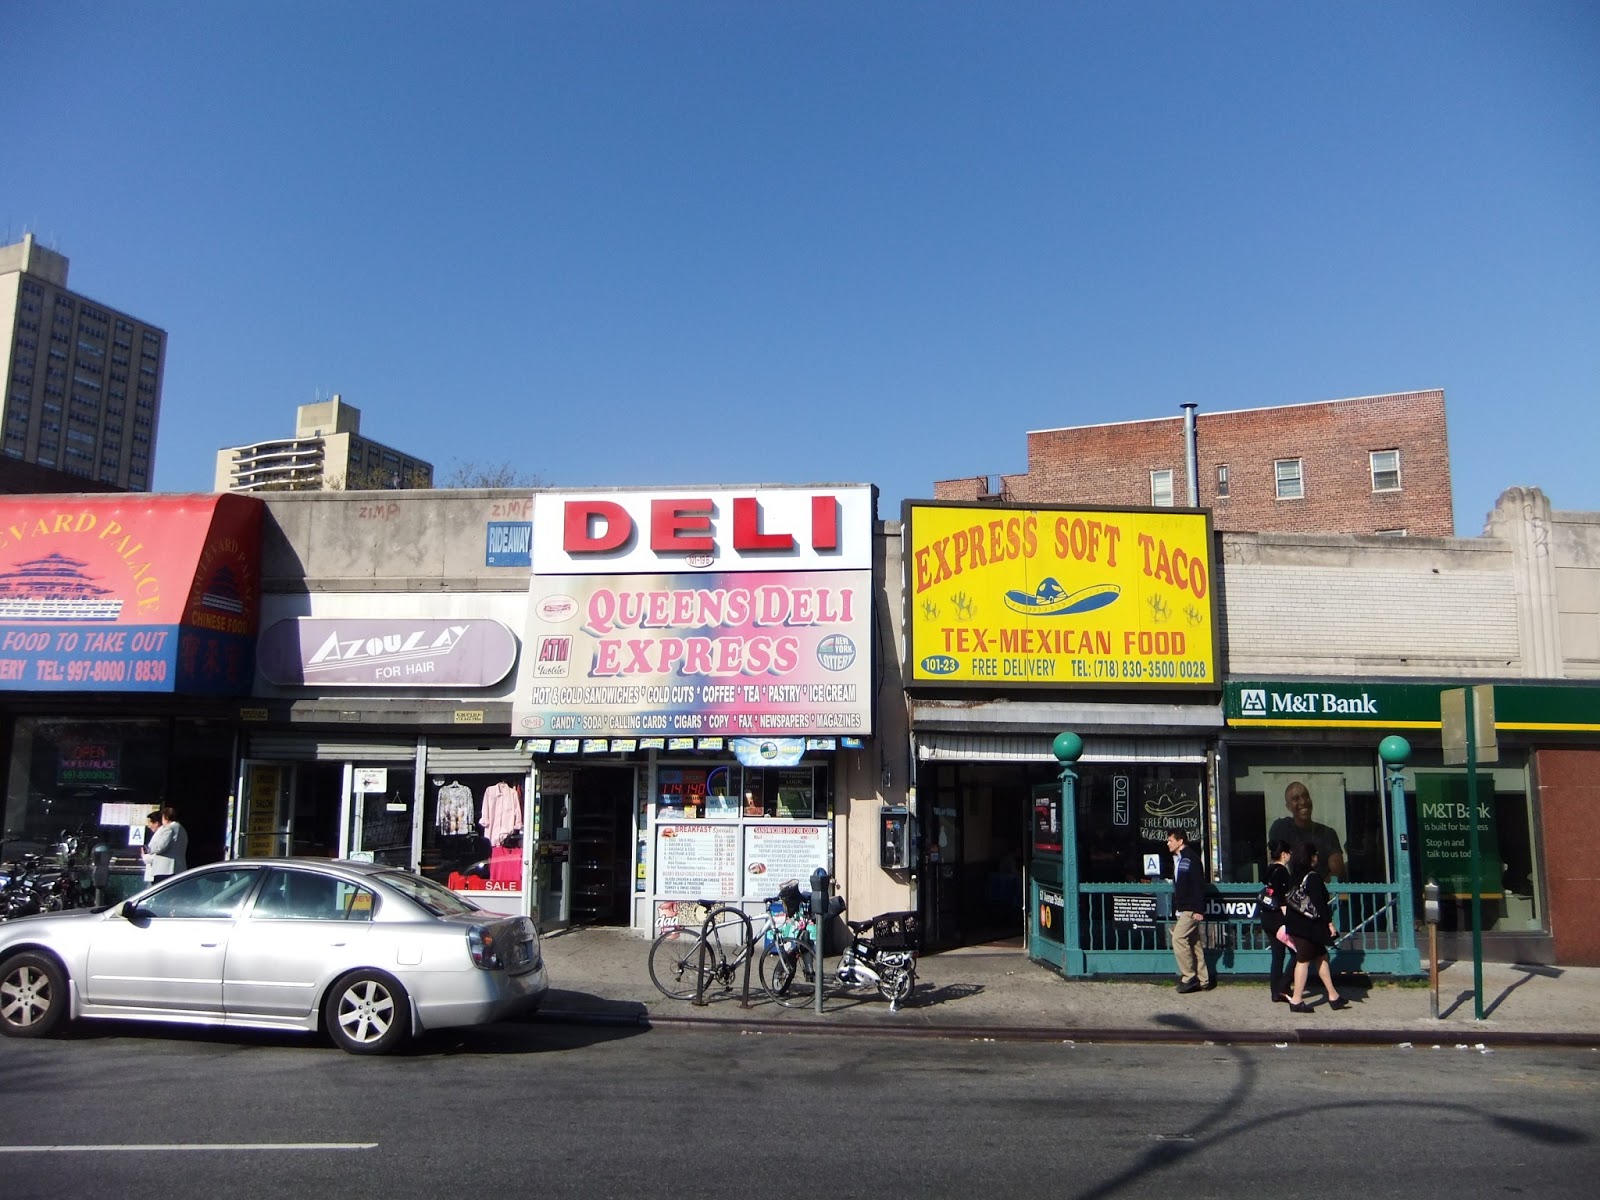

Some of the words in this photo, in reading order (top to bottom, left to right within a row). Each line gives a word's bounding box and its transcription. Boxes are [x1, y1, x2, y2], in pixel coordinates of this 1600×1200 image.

[563, 496, 838, 553] DELI
[99, 520, 160, 616] PALACE
[914, 516, 1038, 594] EXPRESS
[1054, 516, 1121, 568] SOFT
[1137, 532, 1208, 600] TACO
[584, 588, 750, 634] QUEENS
[756, 585, 854, 624] DELI
[191, 610, 227, 632] CHINESE
[227, 618, 249, 634] FOOD
[3, 631, 51, 651] FOOD
[57, 632, 80, 651] TO
[85, 632, 124, 652] TAKE
[131, 632, 168, 652] OUT
[308, 624, 470, 665] AZOULAY
[539, 638, 569, 662] ATM
[835, 637, 849, 645] NEW
[835, 645, 853, 653] YORK
[940, 627, 1112, 656] TEX-MEXICAN
[1123, 630, 1186, 656] FOOD
[593, 636, 800, 675] EXPRESS
[818, 653, 854, 670] LOTTERY
[925, 659, 956, 672] 101-23
[37, 660, 65, 681] TEL:
[135, 660, 167, 682] 8830
[375, 666, 401, 679] FOR
[406, 661, 435, 675] HAIR
[971, 658, 998, 677] FREE
[1003, 658, 1056, 677] DELIVERY
[1071, 659, 1092, 678] TEL:
[1093, 659, 1120, 679] (718)
[532, 687, 551, 704] HOT
[552, 687, 559, 705] &
[560, 686, 584, 704] COLD
[584, 686, 640, 704] SANDWICHES
[647, 686, 670, 704] COLD
[671, 685, 695, 703] CUTS
[702, 685, 735, 703] COFFEE
[744, 685, 760, 702] TEA
[768, 684, 802, 702] PASTRY
[809, 684, 825, 702] ICE
[825, 684, 856, 702] CREAM
[1271, 693, 1319, 713] M&T
[1321, 693, 1378, 714] Bank
[551, 715, 576, 730] CANDY
[582, 715, 602, 729] SODA
[609, 715, 642, 729] CALLING
[642, 715, 667, 729] CARDS
[674, 714, 702, 729] CIGARS
[708, 714, 730, 728] COPY
[738, 714, 753, 728] FAX
[760, 713, 810, 728] NEWSPAPERS
[816, 713, 861, 728] MAGAZINES
[1115, 777, 1127, 823] OPEN
[1422, 803, 1455, 818] M&T
[133, 829, 141, 840] A
[675, 825, 712, 833] BREAKFAST
[1424, 823, 1430, 831] is
[1431, 822, 1447, 831] built
[1448, 822, 1458, 831] for
[1460, 822, 1489, 831] busess
[1426, 838, 1442, 848] Stop
[1443, 839, 1451, 847] in
[1451, 838, 1465, 847] and
[1147, 858, 1157, 869] A
[1427, 850, 1440, 858] talk
[485, 881, 517, 891] SALE
[1205, 899, 1257, 918] ubway
